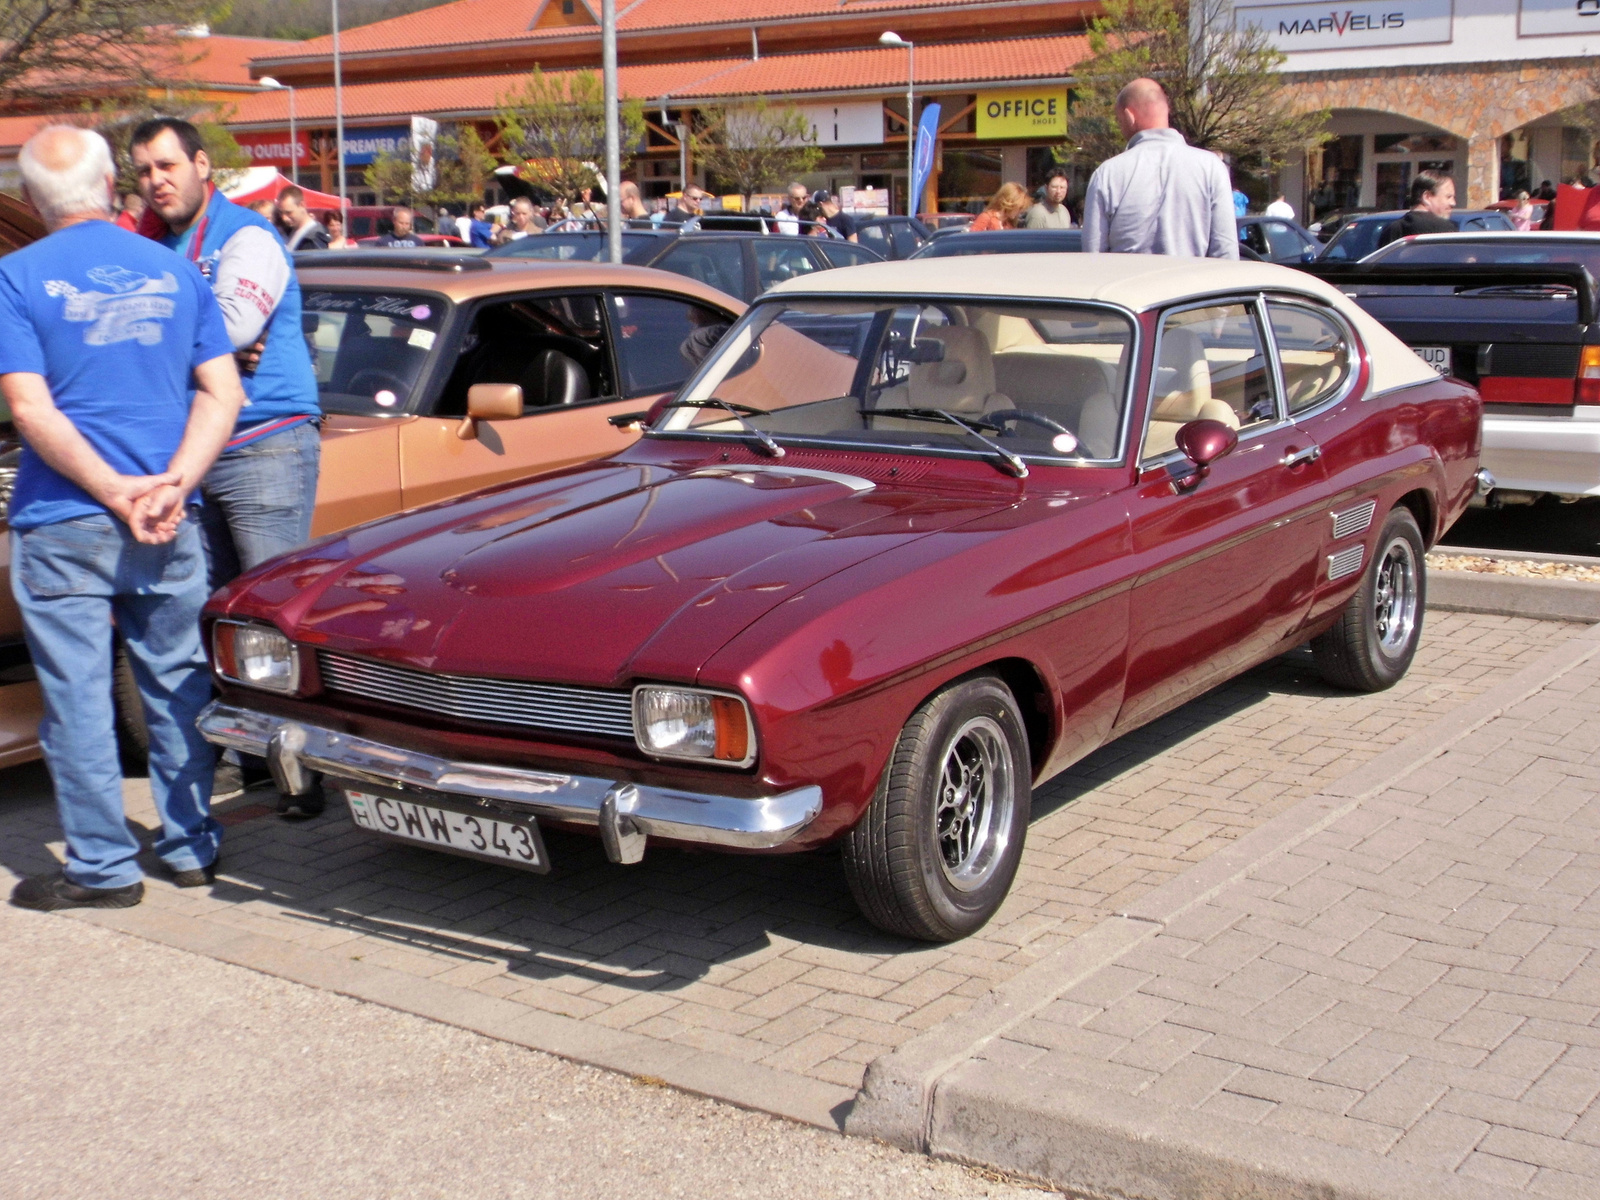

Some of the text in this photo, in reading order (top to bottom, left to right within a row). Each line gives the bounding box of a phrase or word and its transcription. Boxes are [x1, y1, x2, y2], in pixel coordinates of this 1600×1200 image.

[987, 98, 1057, 118] OFFICE
[342, 137, 396, 154] PREMIER
[353, 798, 535, 861] H GWW-343
